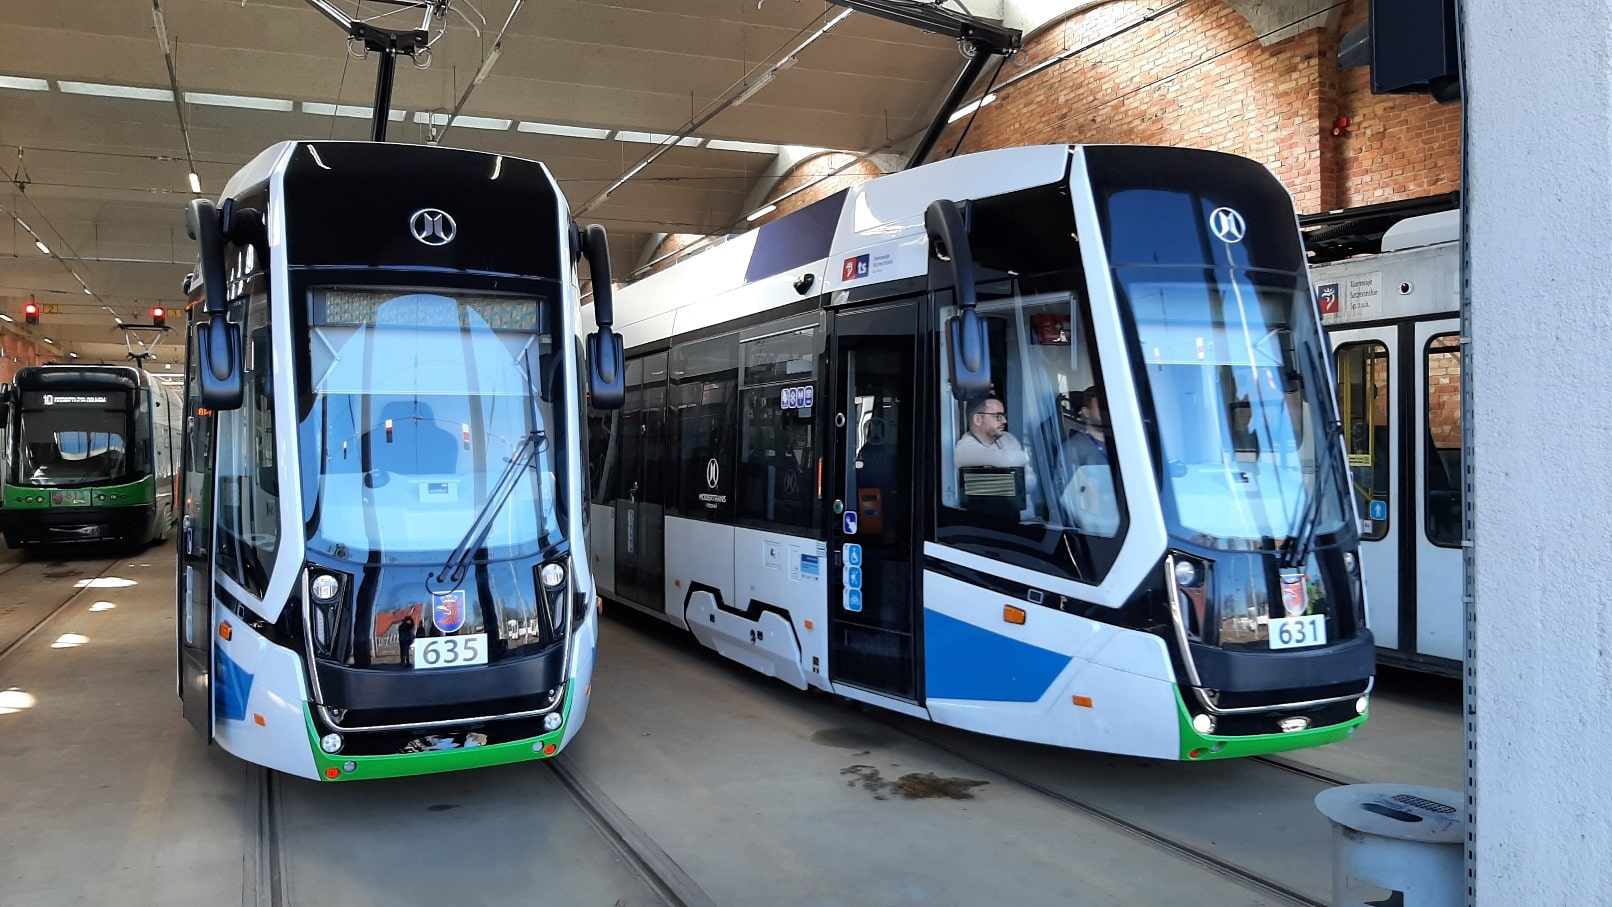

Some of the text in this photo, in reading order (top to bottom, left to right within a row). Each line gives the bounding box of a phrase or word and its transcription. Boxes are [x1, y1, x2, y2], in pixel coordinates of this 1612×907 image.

[857, 261, 867, 274] ts
[43, 394, 54, 405] 10
[1279, 619, 1317, 644] 631
[423, 637, 478, 665] 635
